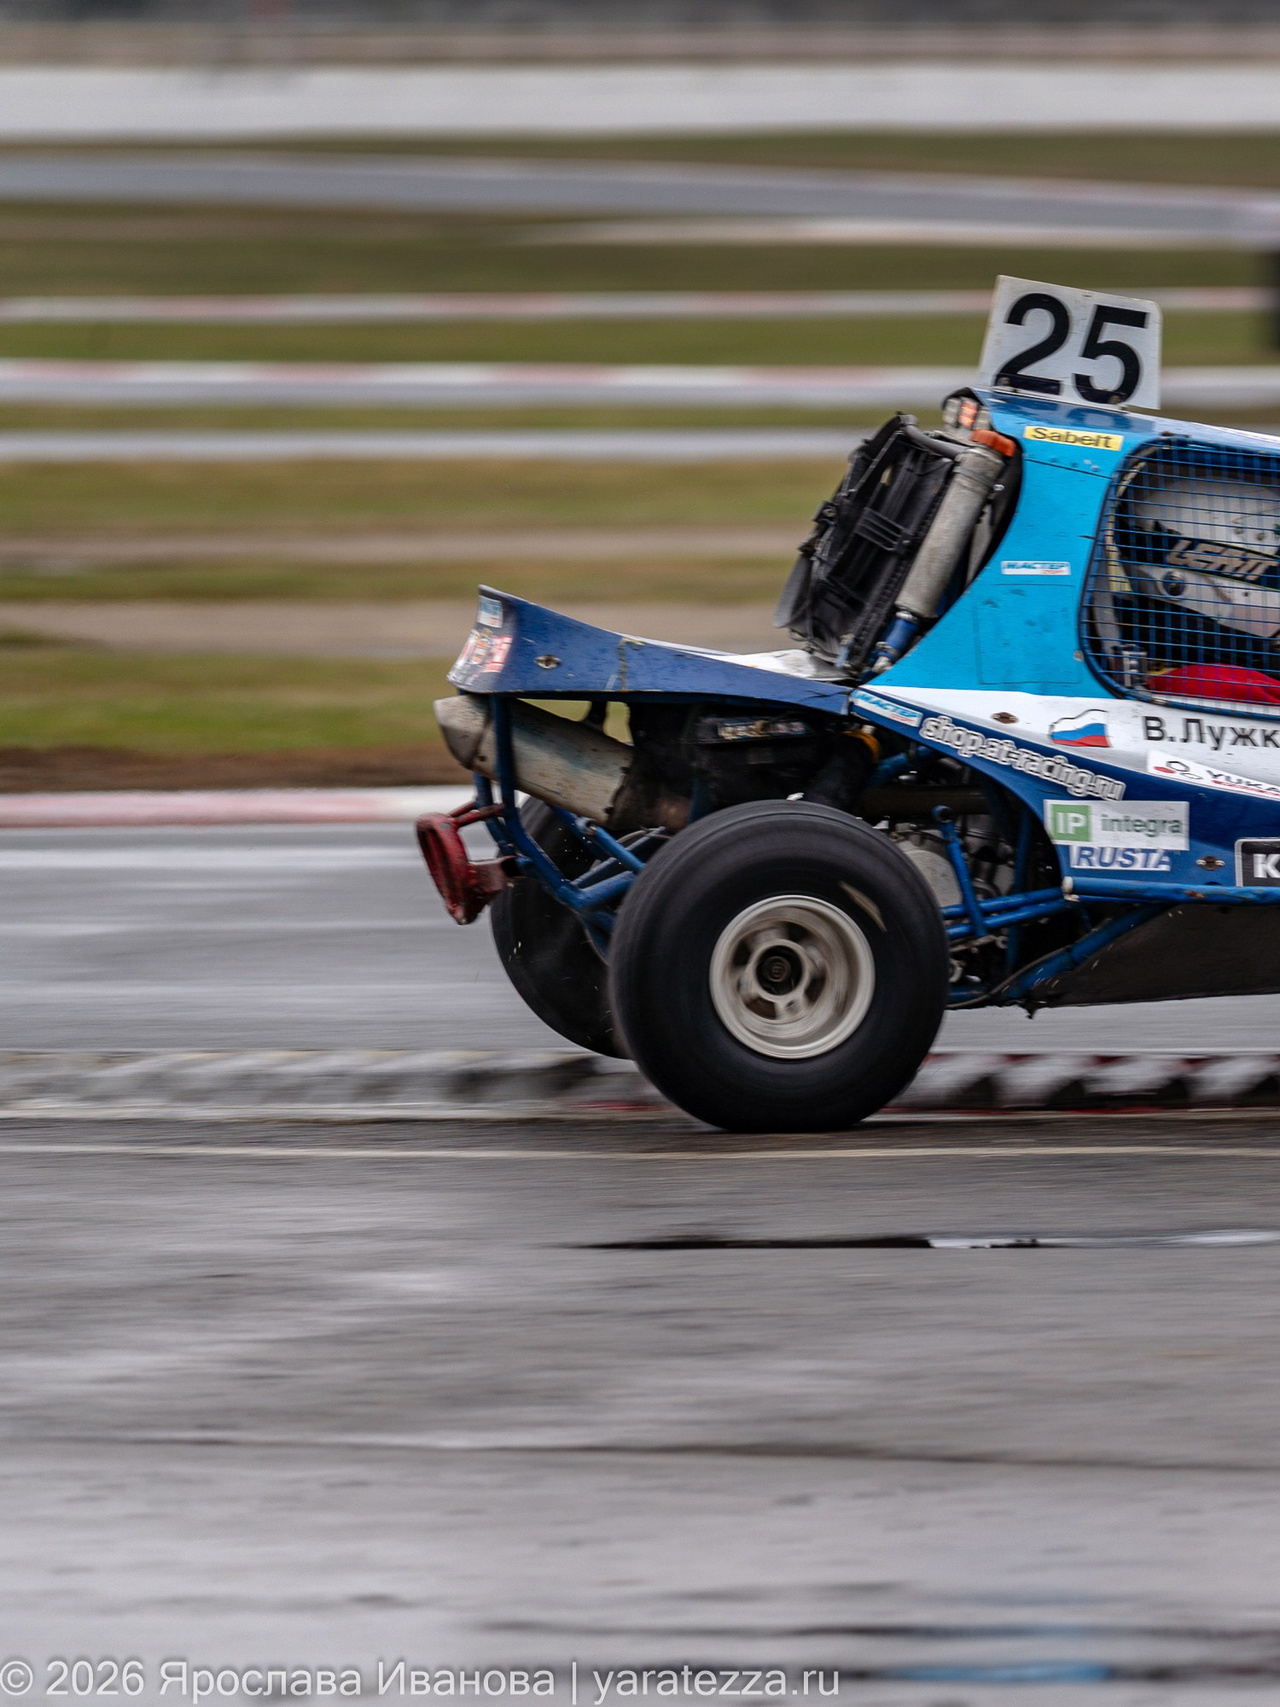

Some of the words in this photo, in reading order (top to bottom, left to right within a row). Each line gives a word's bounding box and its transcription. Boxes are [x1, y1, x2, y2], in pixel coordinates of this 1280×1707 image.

[994, 292, 1150, 405] 25
[1055, 812, 1087, 835] IP
[1101, 813, 1182, 838] integra
